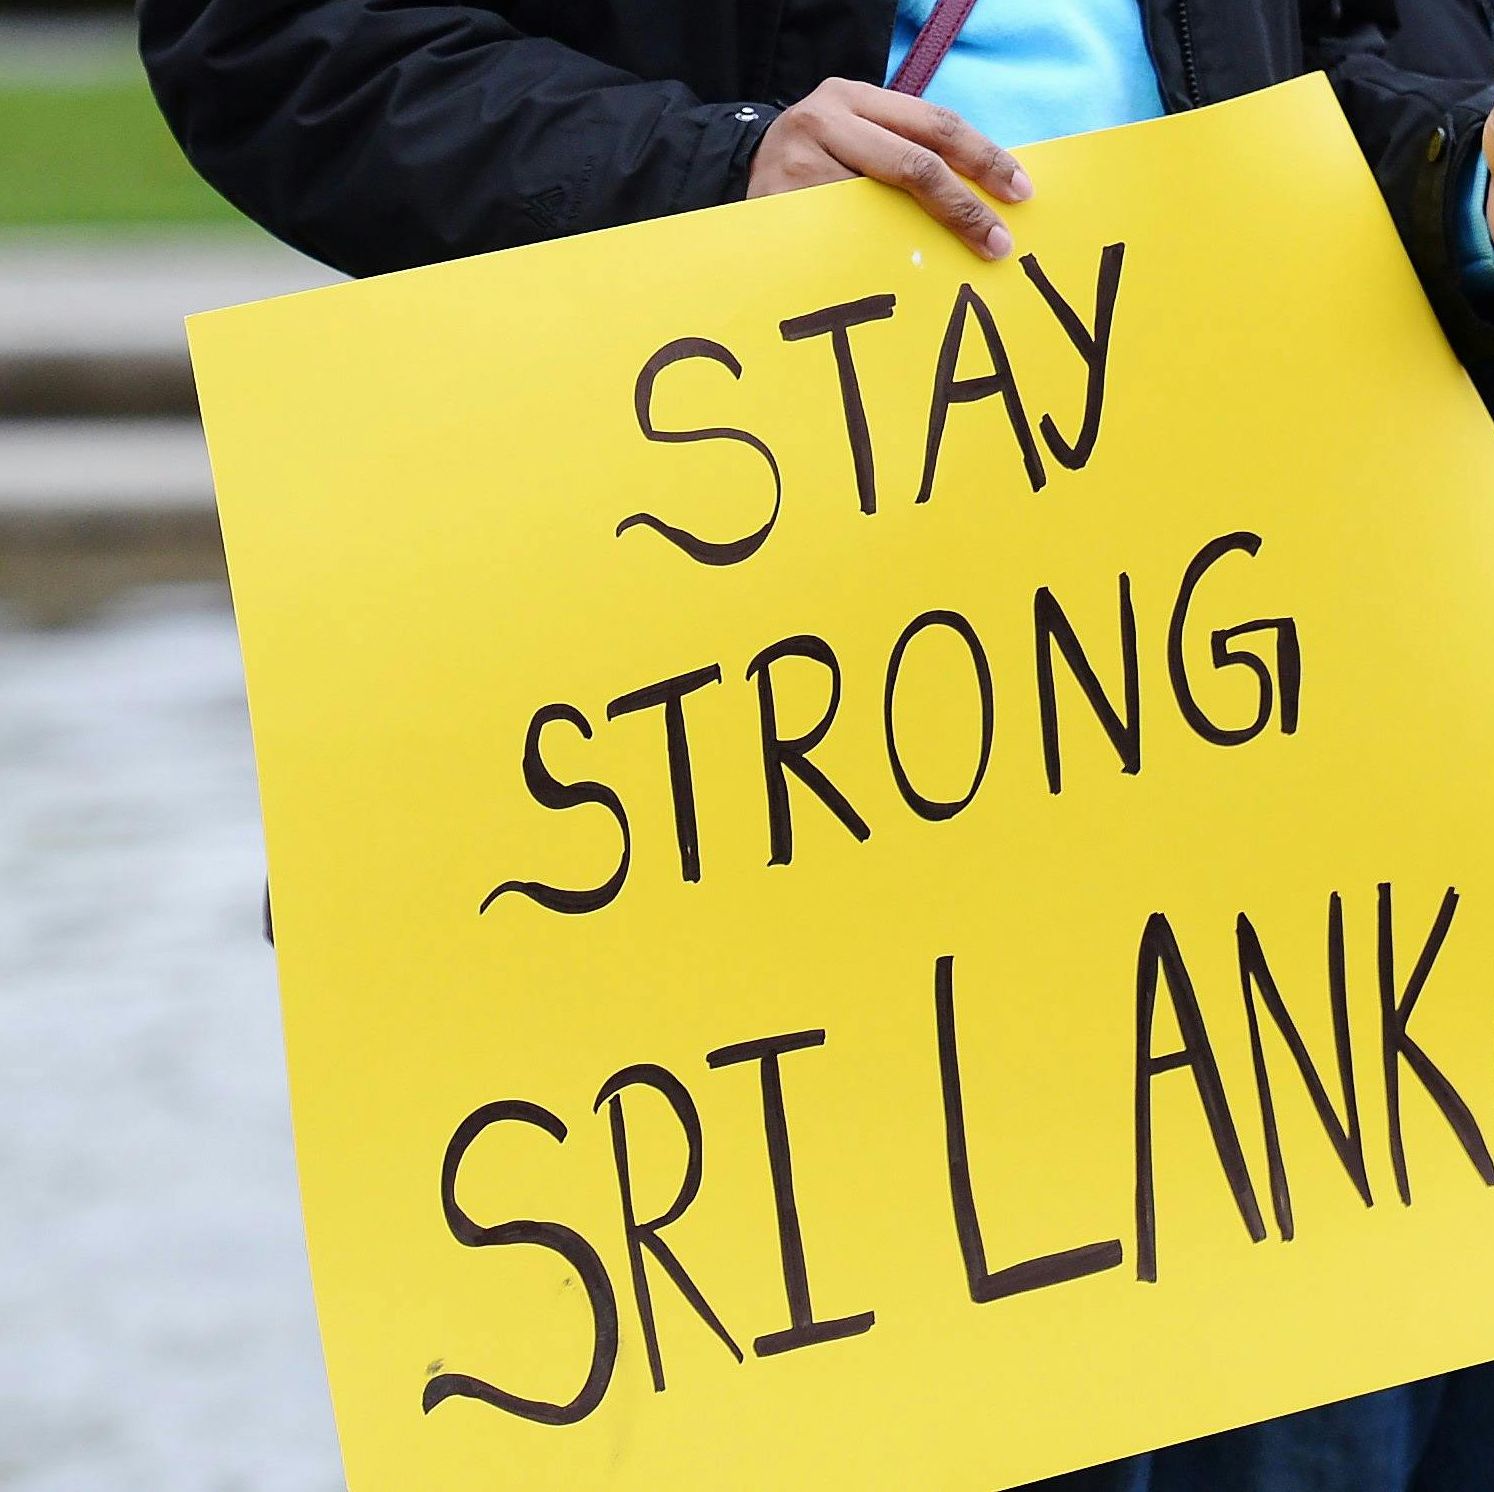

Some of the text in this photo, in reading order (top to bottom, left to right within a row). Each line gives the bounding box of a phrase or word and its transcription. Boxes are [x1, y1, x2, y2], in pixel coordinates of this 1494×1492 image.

[616, 242, 1127, 567] STAY
[479, 531, 1302, 915] STRONG
[421, 1027, 877, 1426] SRI
